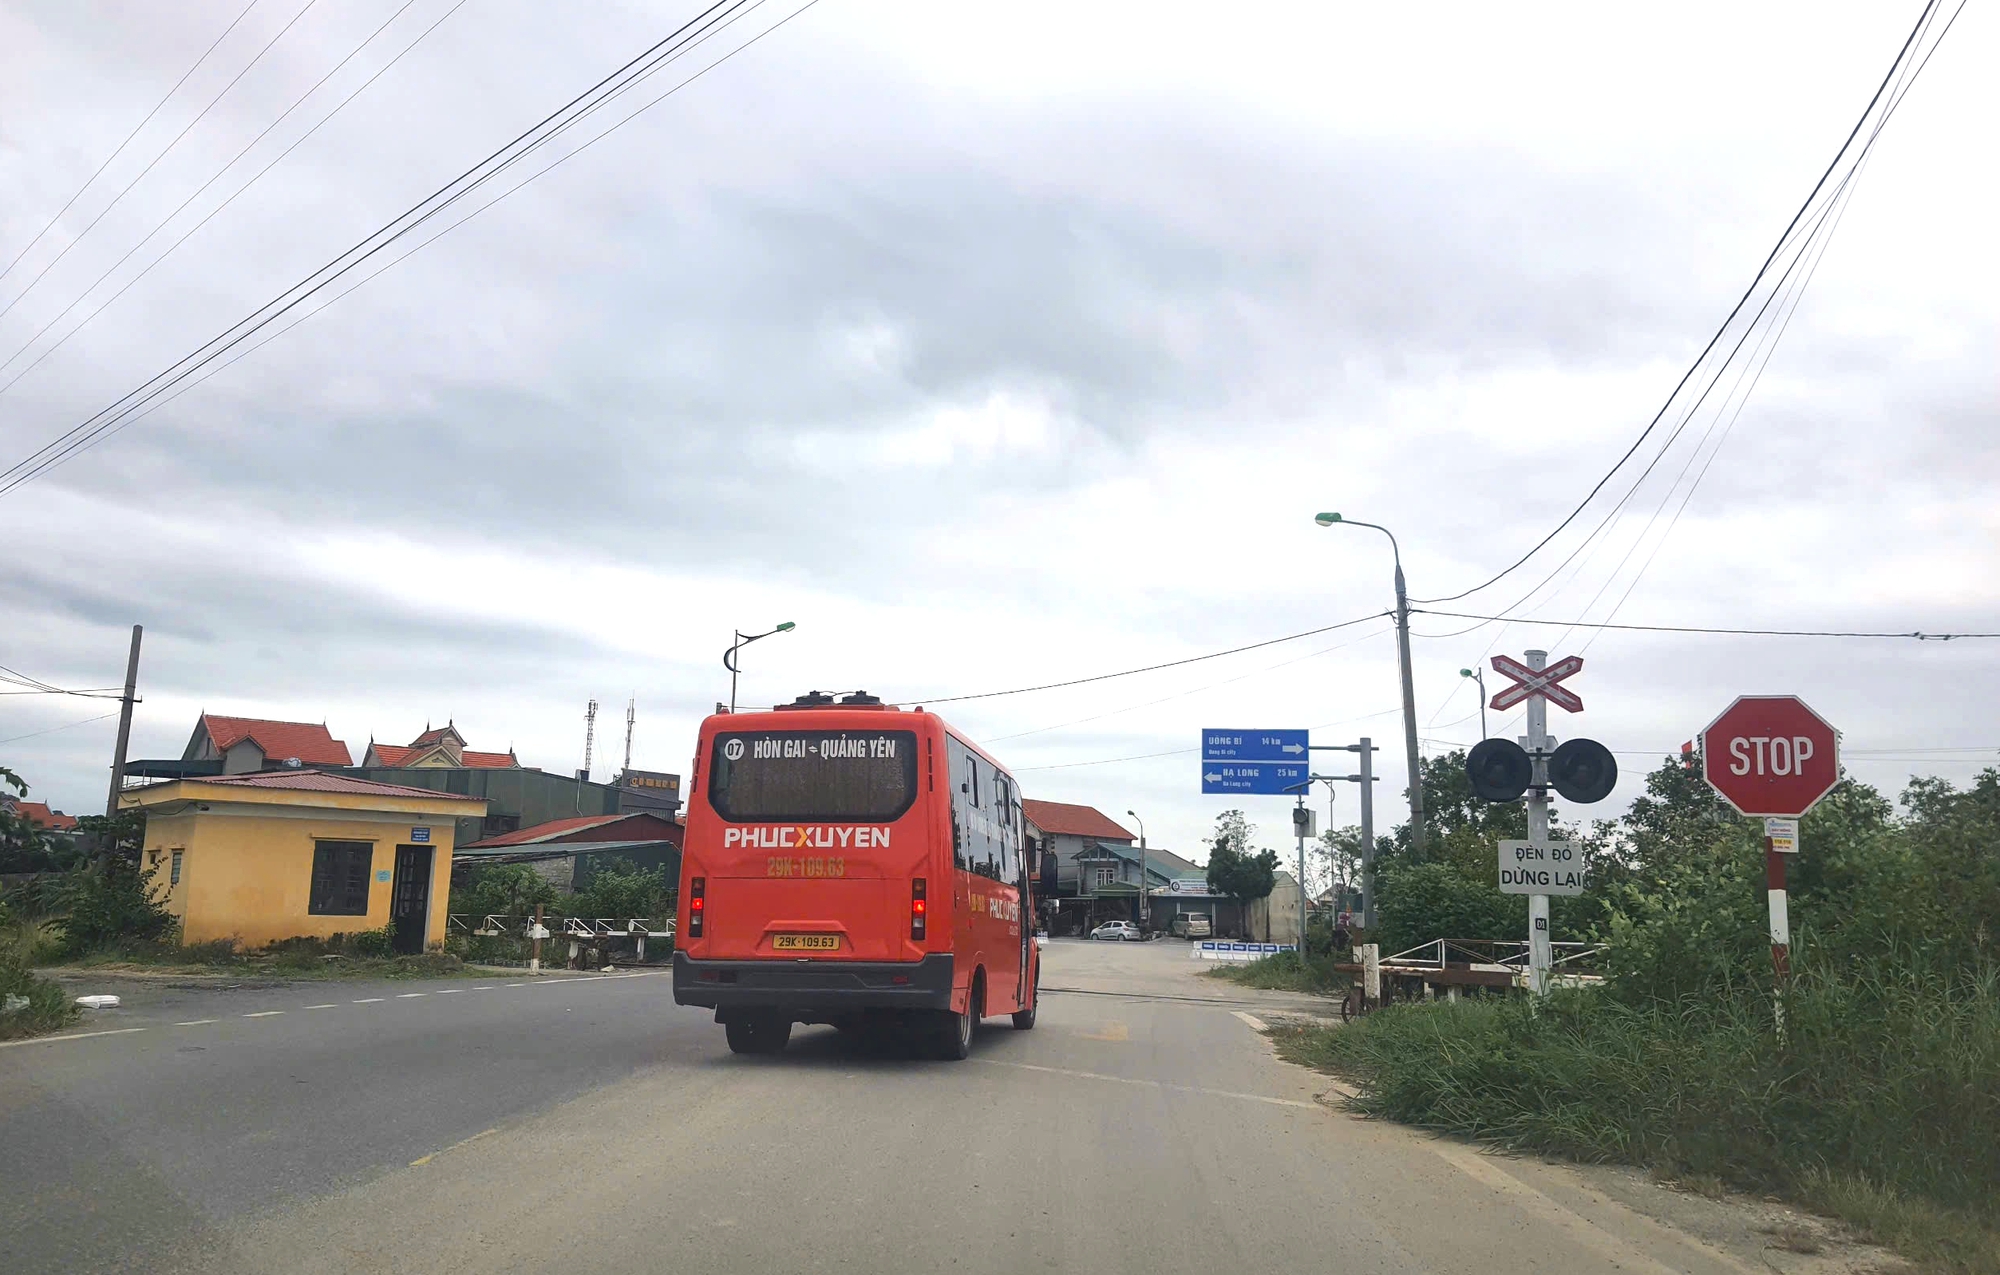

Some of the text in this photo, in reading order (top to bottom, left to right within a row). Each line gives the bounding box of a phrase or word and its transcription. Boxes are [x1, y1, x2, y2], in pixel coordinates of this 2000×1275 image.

[728, 742, 742, 757] 07
[754, 734, 896, 760] HÒN GAI QUẢNG YÊN
[1261, 737, 1281, 745] 14 km
[1729, 736, 1814, 776] STOP
[1222, 768, 1260, 778] HẠ LONG
[1277, 768, 1298, 777] 25 km
[767, 857, 845, 877] 29K-109.63
[1501, 866, 1582, 889] DỪNG LẠI
